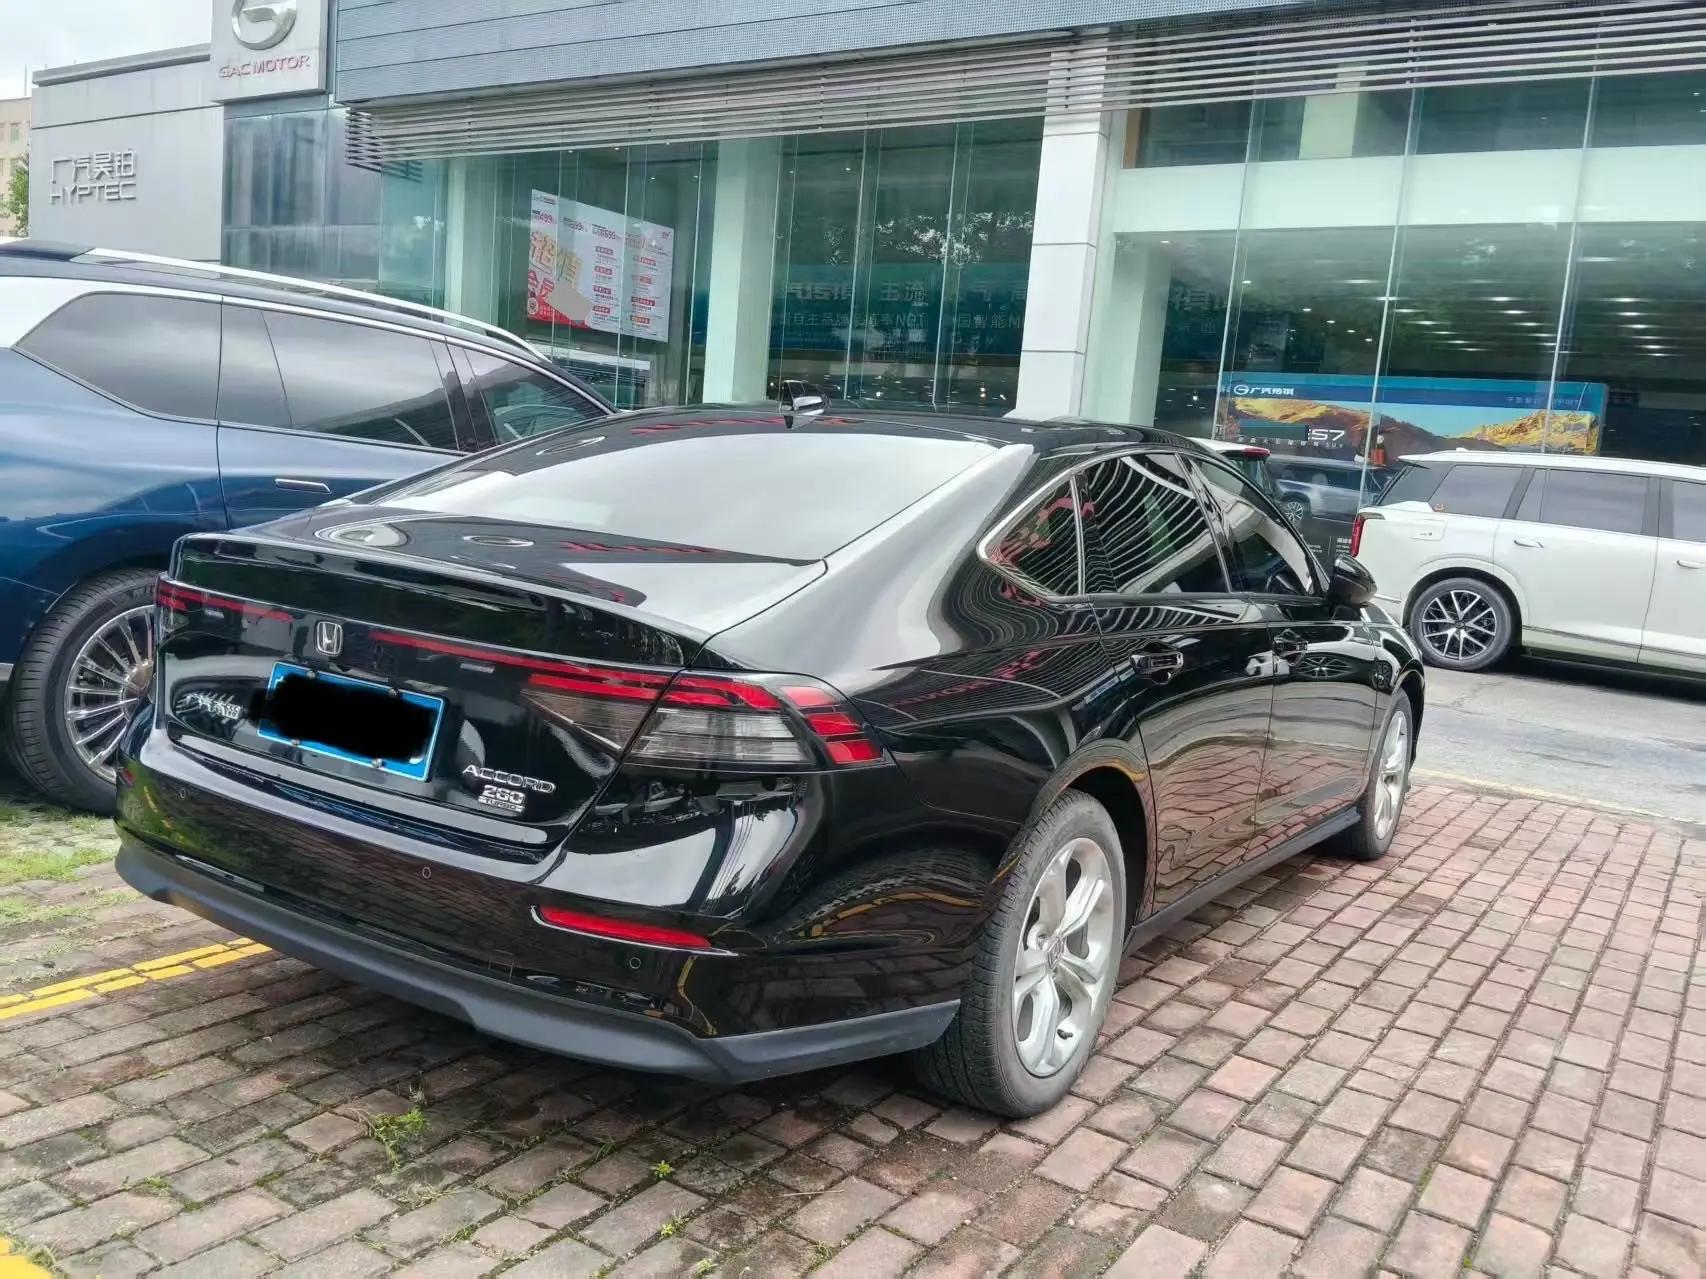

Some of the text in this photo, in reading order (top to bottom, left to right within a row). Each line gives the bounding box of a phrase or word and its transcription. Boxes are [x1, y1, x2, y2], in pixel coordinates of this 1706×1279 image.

[51, 149, 136, 183] 广汽昊铂
[50, 181, 136, 205] HYPTEC
[462, 764, 556, 793] ACCORD
